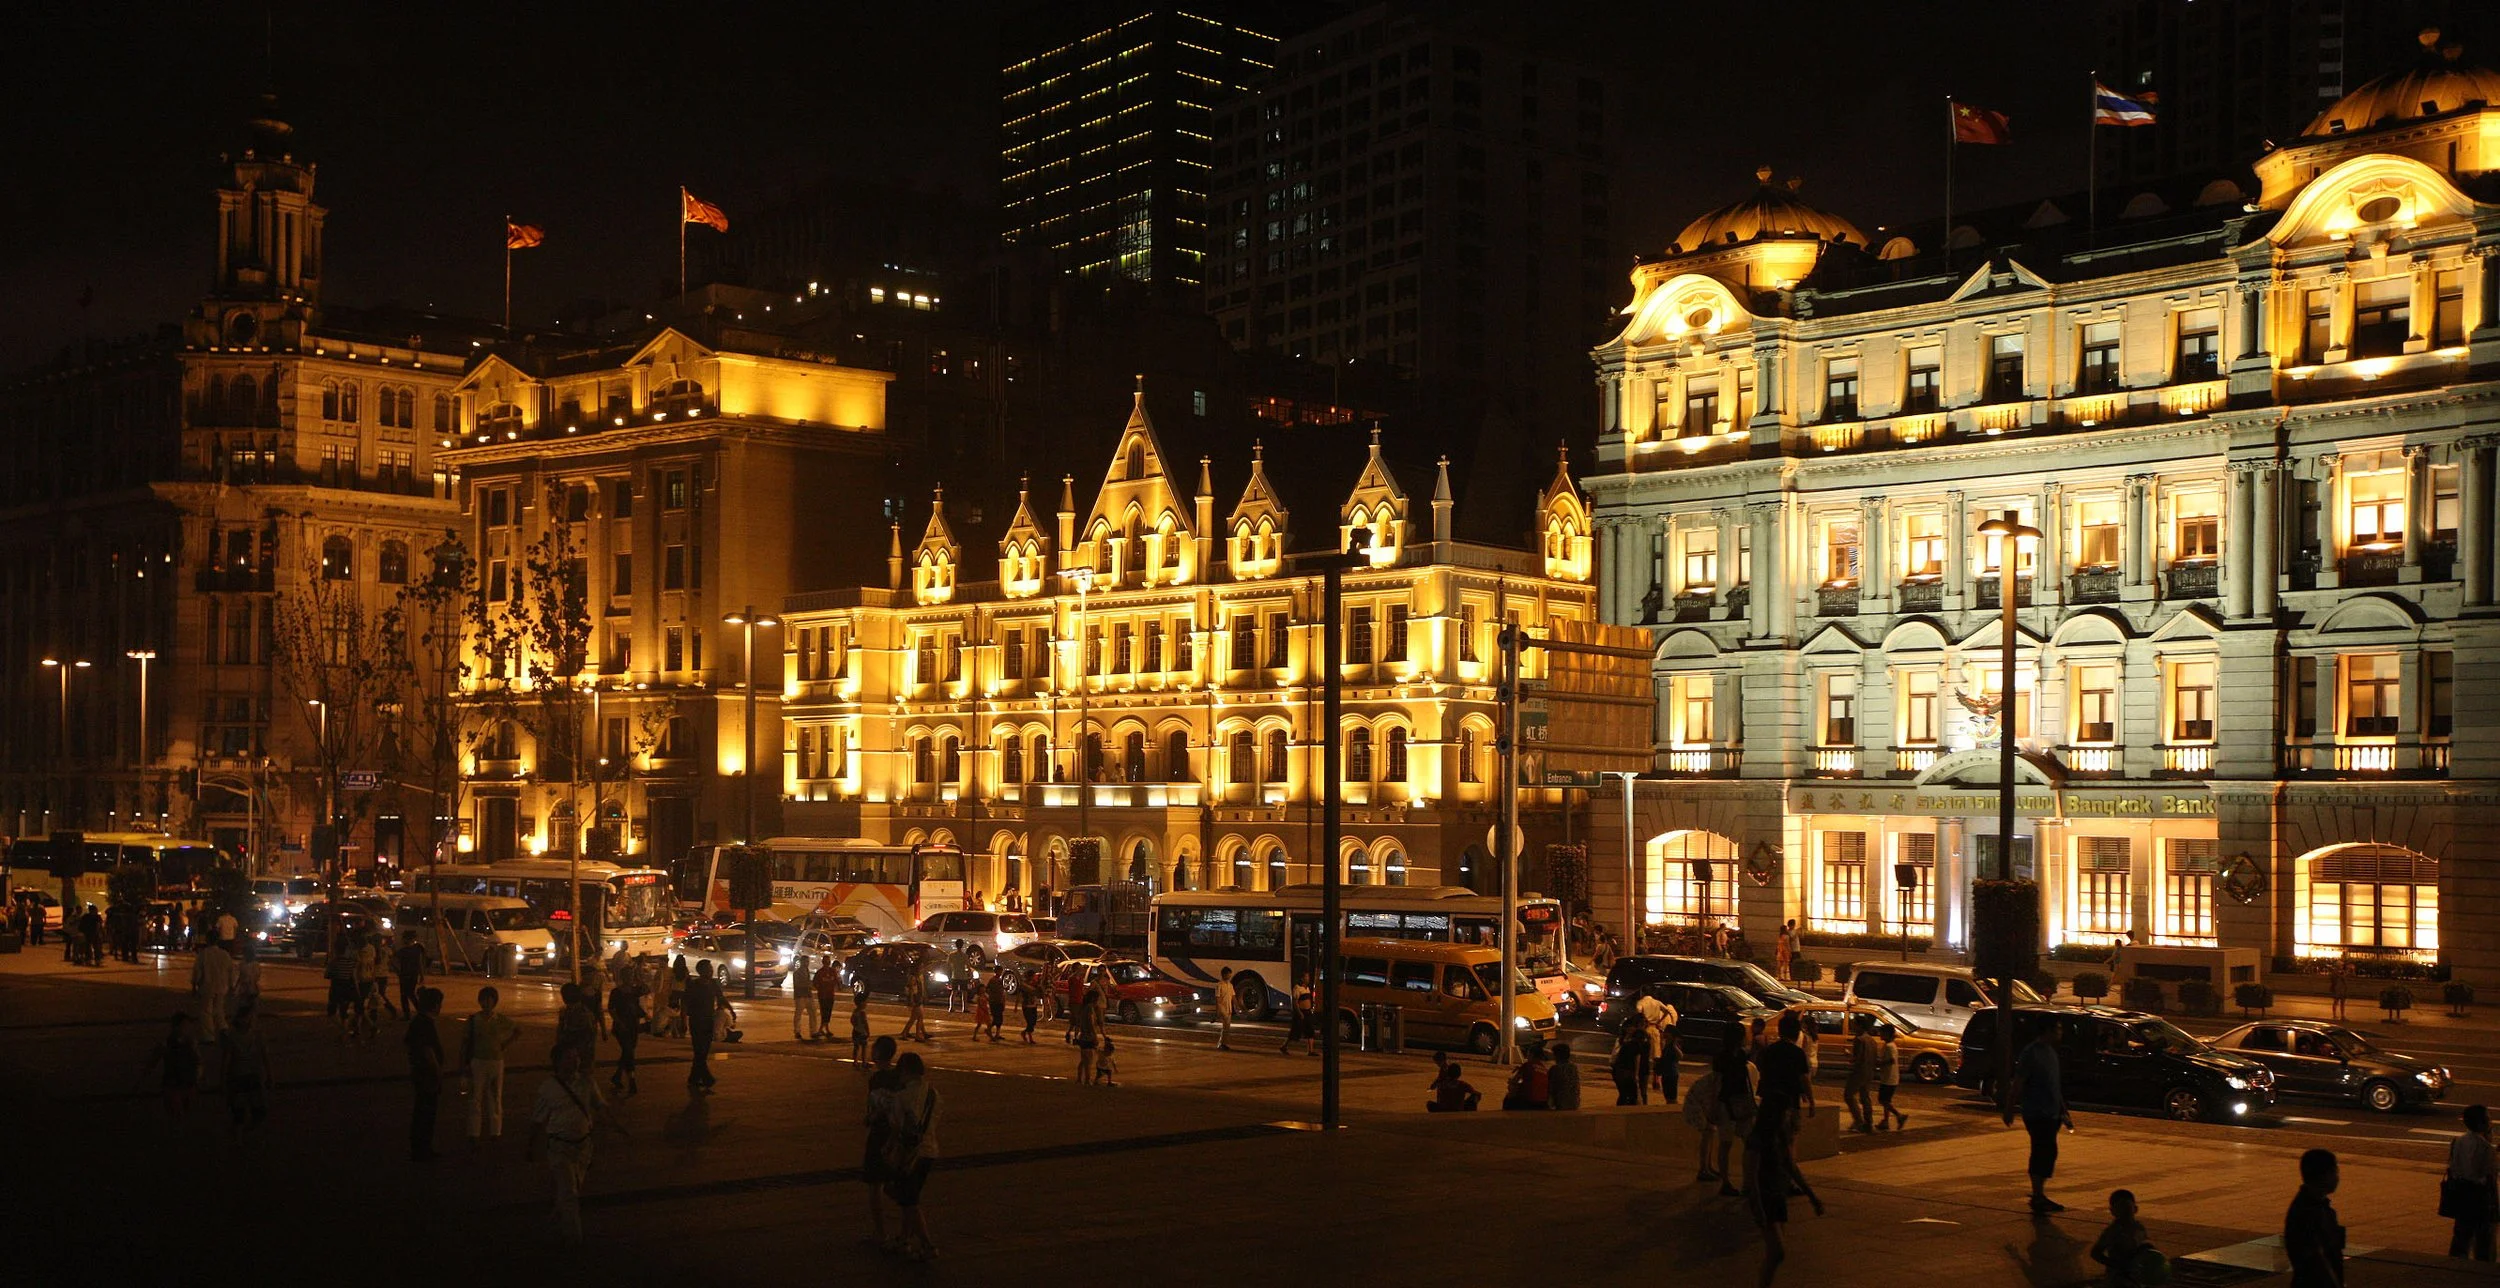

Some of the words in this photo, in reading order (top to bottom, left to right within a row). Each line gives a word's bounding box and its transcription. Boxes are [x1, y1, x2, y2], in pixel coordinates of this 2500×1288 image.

[1547, 773, 1573, 784] Entrance
[2065, 794, 2154, 817] Bangkok
[2161, 794, 2216, 814] Bank
